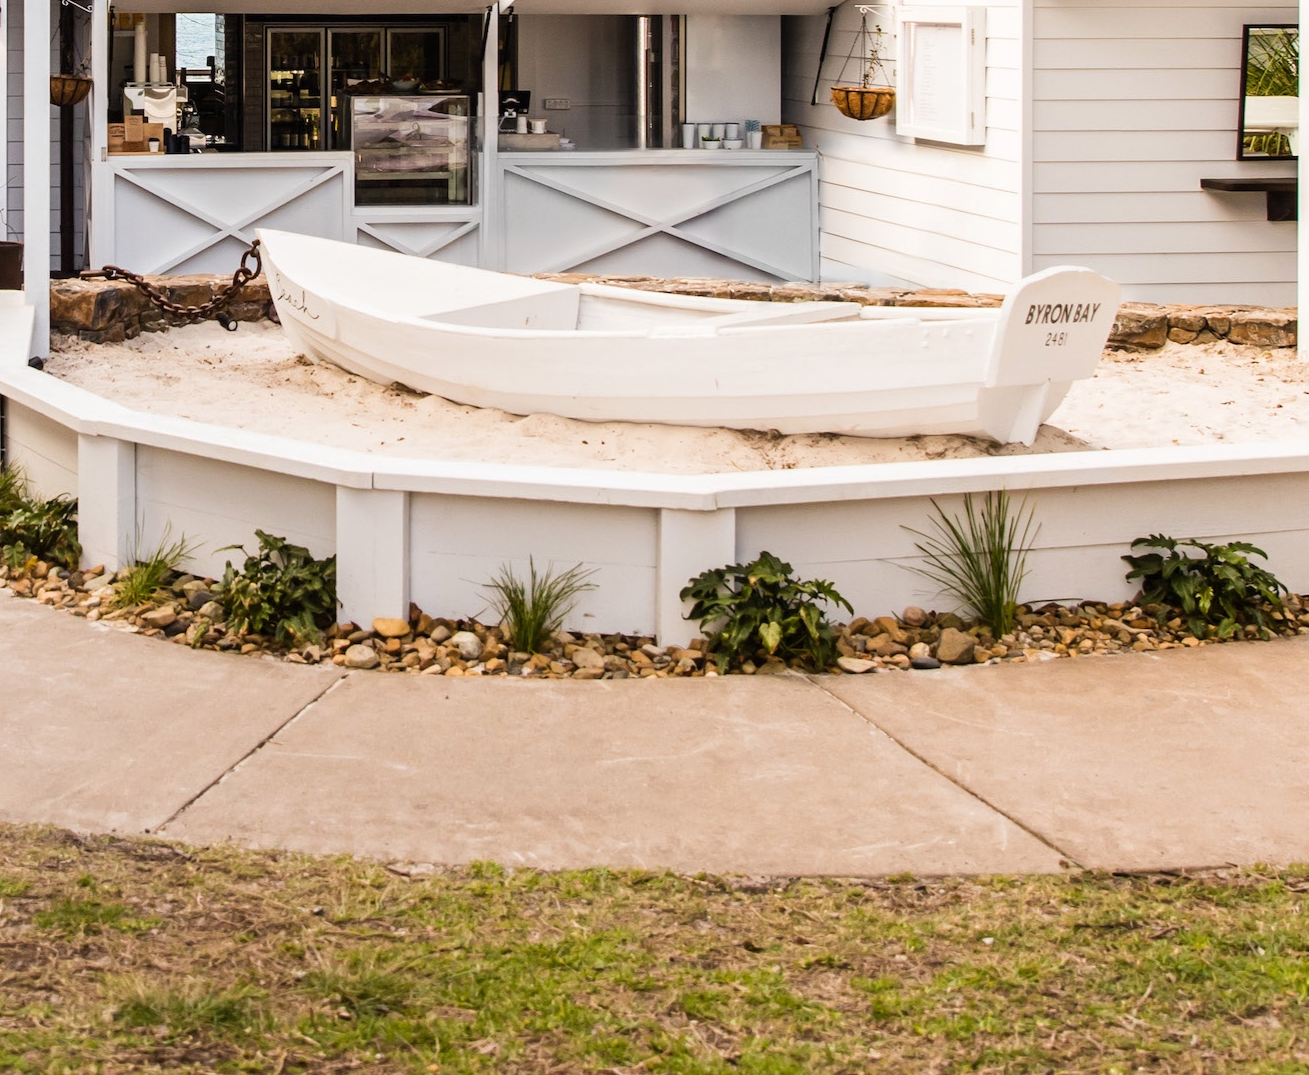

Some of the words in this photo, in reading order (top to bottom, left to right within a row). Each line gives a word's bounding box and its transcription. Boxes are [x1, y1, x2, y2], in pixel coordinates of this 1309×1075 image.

[1025, 304, 1073, 325] BYRON
[1073, 303, 1101, 323] BAY
[1045, 332, 1068, 347] 2481
